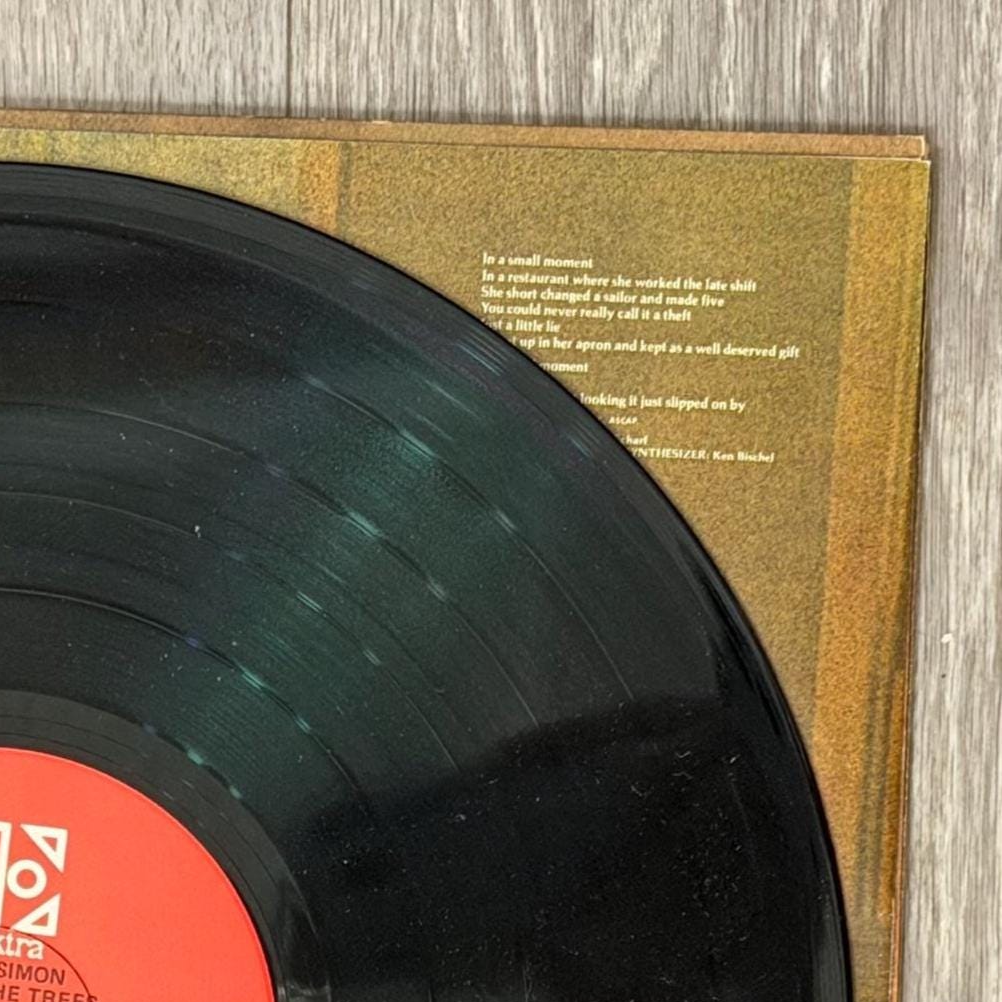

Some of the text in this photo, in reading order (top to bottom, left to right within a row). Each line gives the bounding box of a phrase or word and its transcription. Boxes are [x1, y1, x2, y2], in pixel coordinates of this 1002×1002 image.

[482, 252, 594, 269] In a small moment
[482, 270, 757, 293] In a restaurant where she worked the late shift
[481, 285, 725, 307] She short changed a sailor and made five
[481, 301, 692, 322] You could never really call it a theft
[505, 319, 560, 333] a little lie
[520, 339, 535, 349] up
[538, 337, 550, 348] in
[553, 337, 573, 349] her
[576, 341, 611, 353] apron
[614, 339, 637, 352] and
[640, 340, 666, 356] kept
[669, 345, 682, 354] as
[685, 345, 692, 354] a
[695, 342, 721, 355] well
[723, 344, 776, 357] deserved
[778, 346, 800, 360] gift
[541, 362, 589, 373] moment
[580, 393, 746, 413] looking it just slipped on by
[713, 451, 775, 463] Ken Bischel
